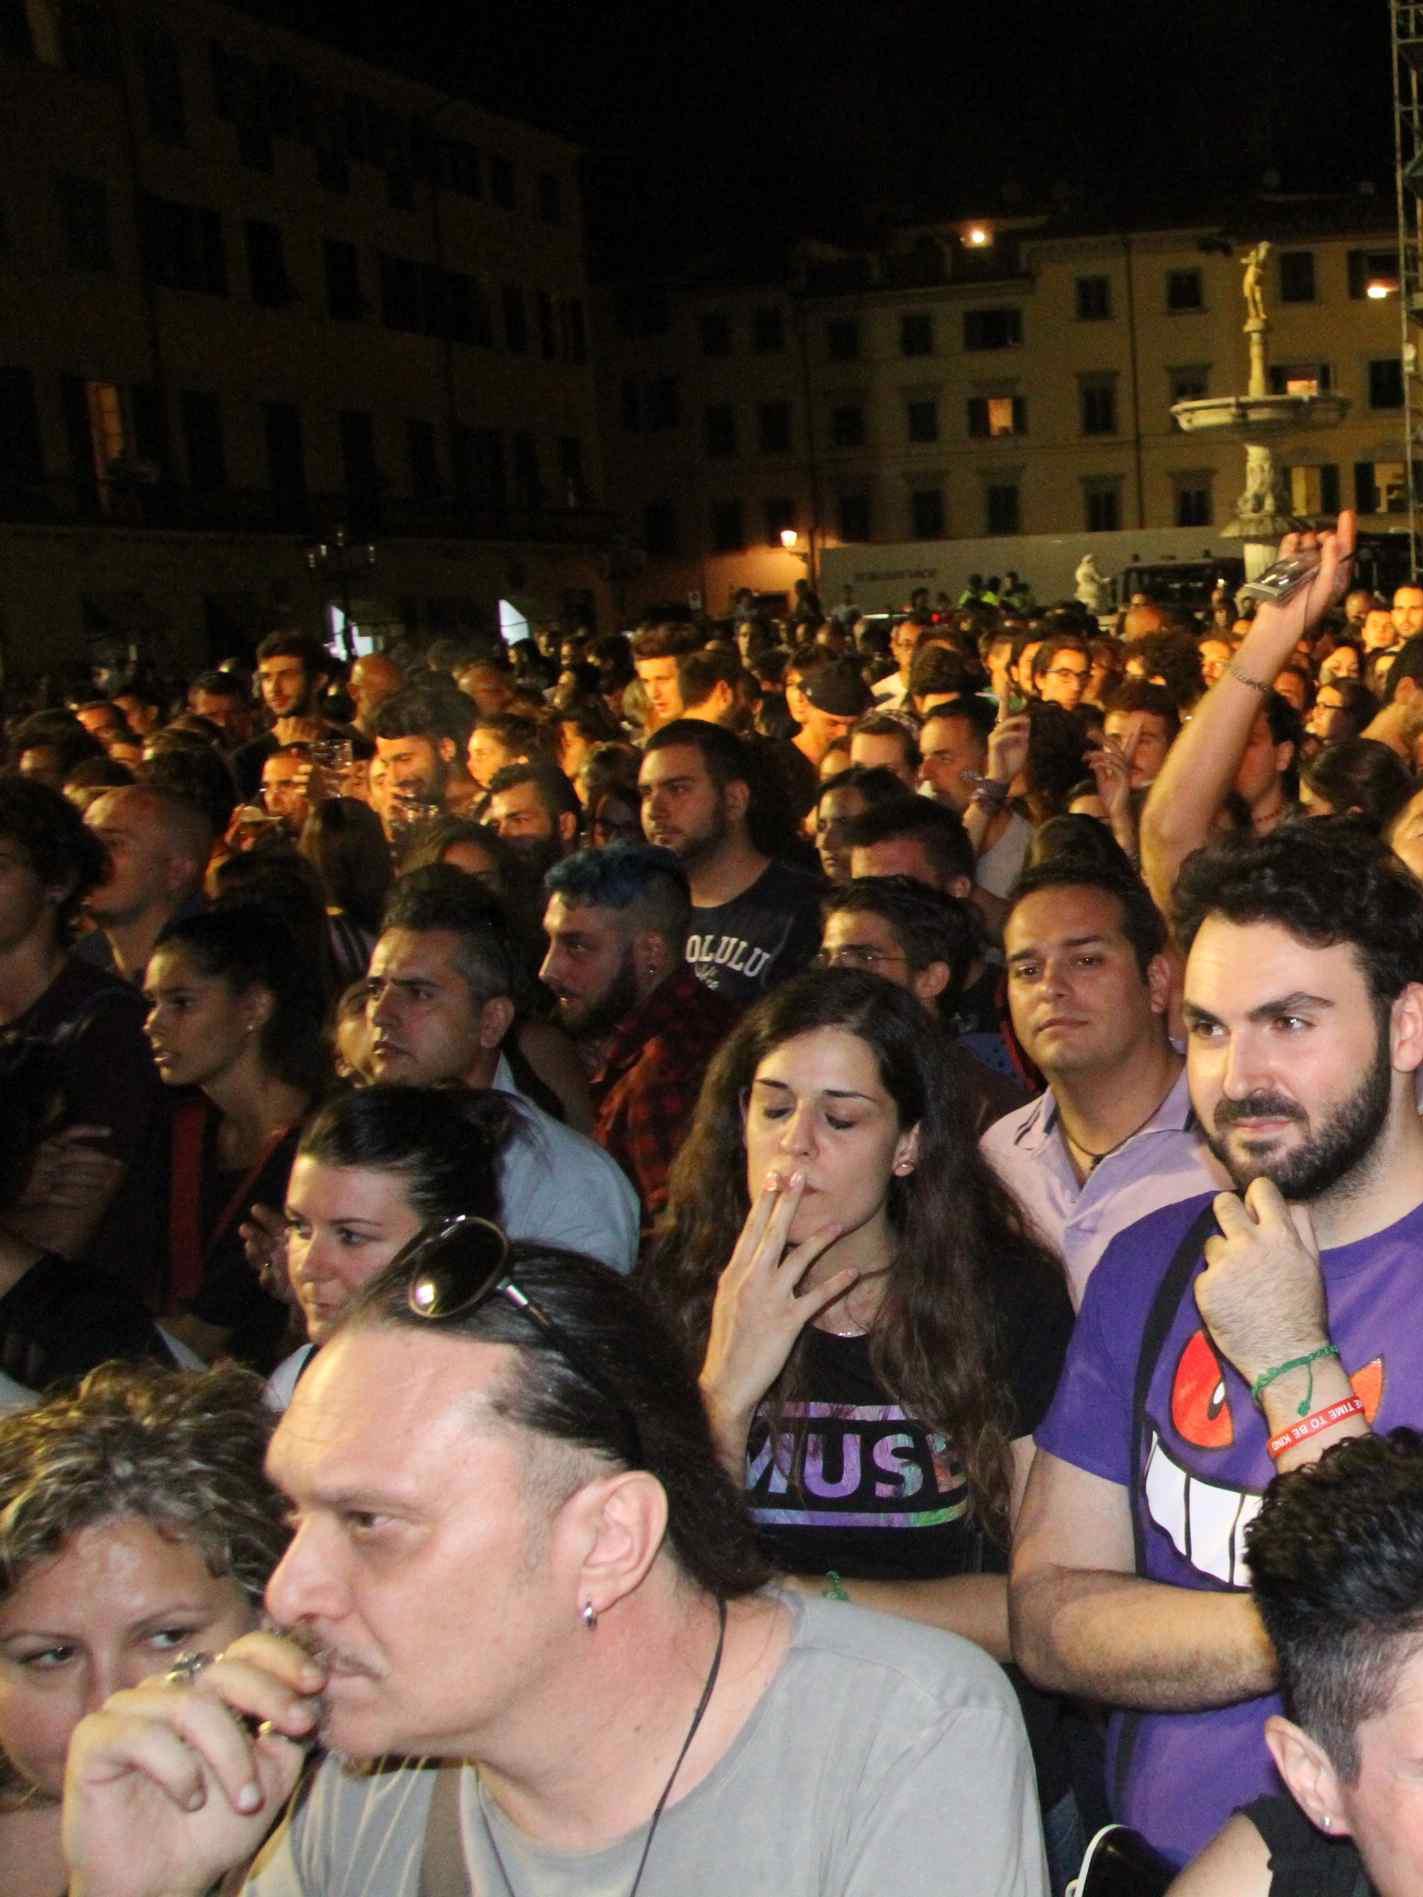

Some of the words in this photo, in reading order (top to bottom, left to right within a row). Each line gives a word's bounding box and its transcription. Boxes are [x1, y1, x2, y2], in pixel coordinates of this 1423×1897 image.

[685, 934, 771, 977] OLULU
[1328, 1401, 1355, 1420] TIME
[1310, 1415, 1329, 1430] TO
[1292, 1424, 1309, 1439] BE
